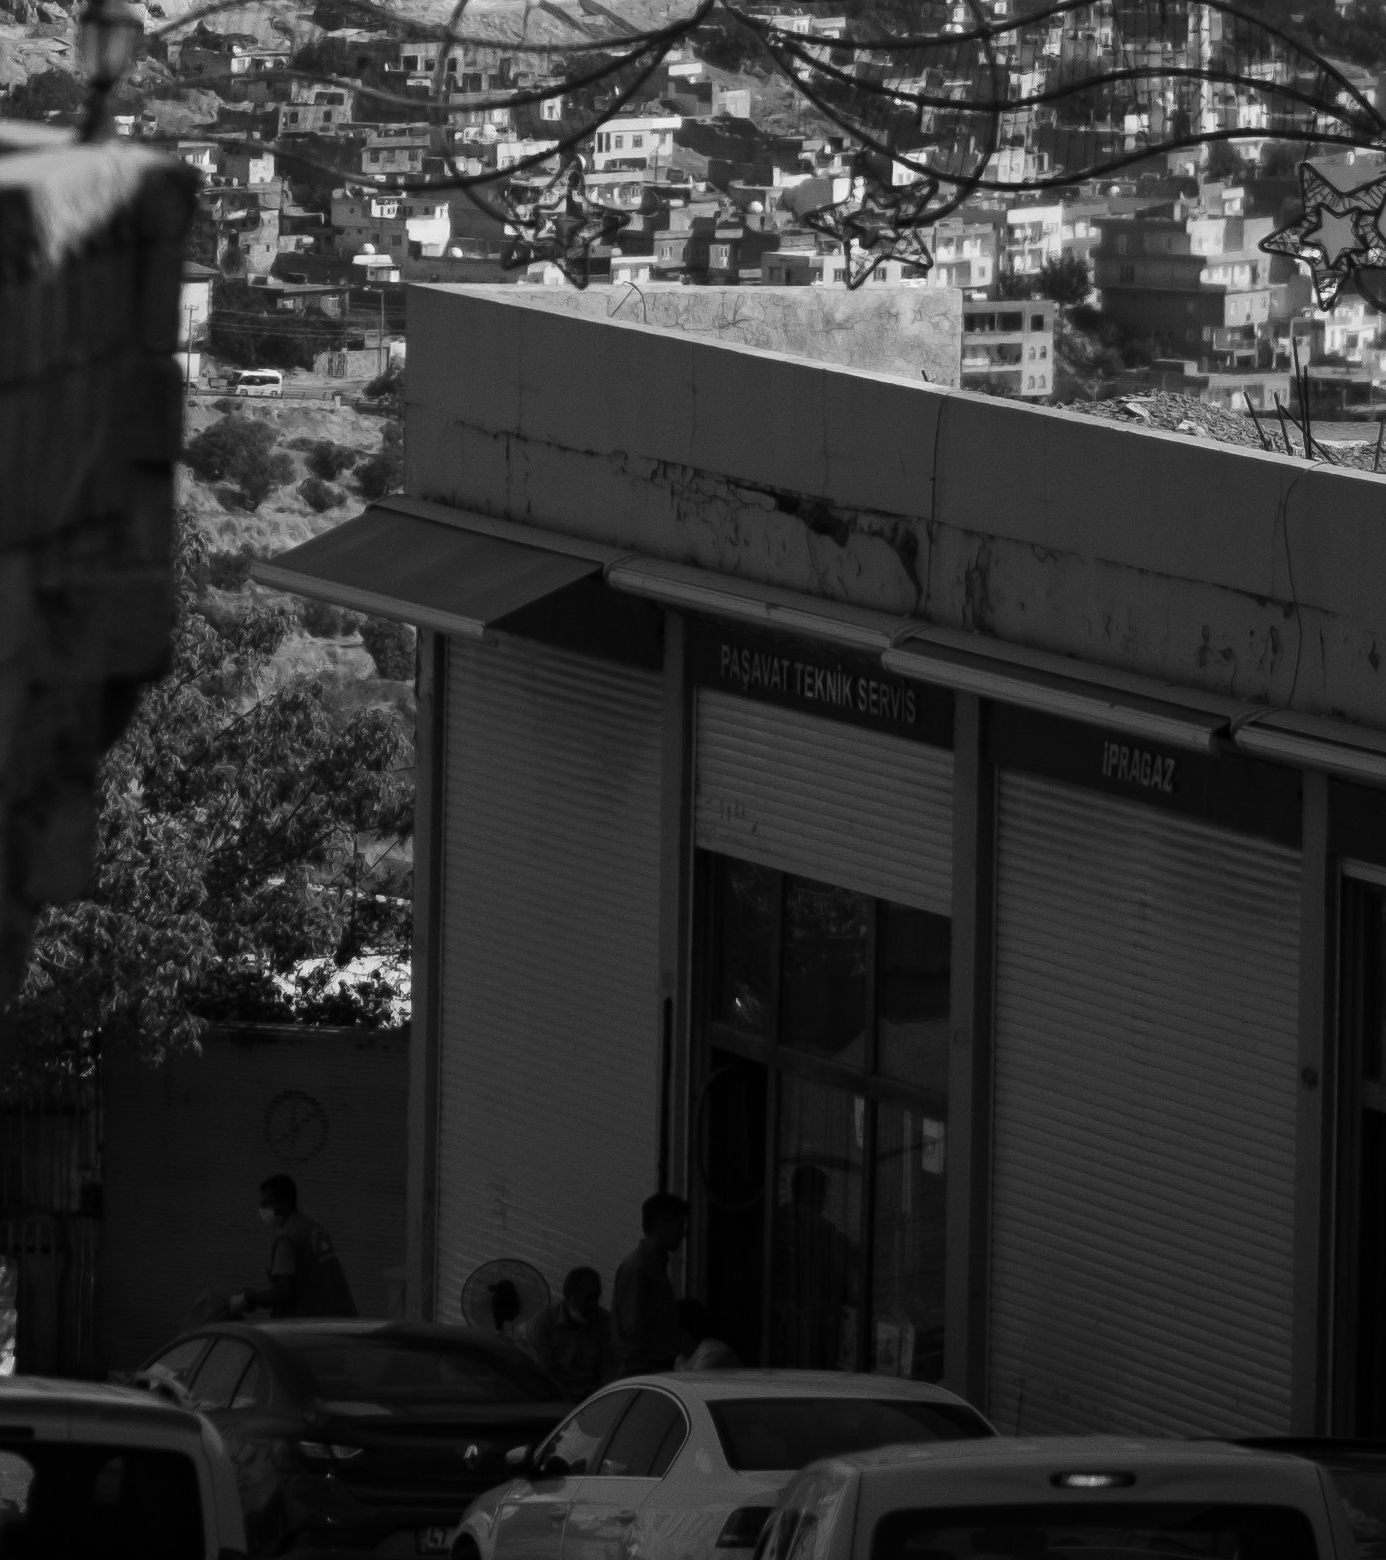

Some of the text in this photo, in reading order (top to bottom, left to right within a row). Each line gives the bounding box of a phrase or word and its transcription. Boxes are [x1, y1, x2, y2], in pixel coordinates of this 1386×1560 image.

[720, 644, 918, 724] PAŞAVAT TEKNİK SERVİS
